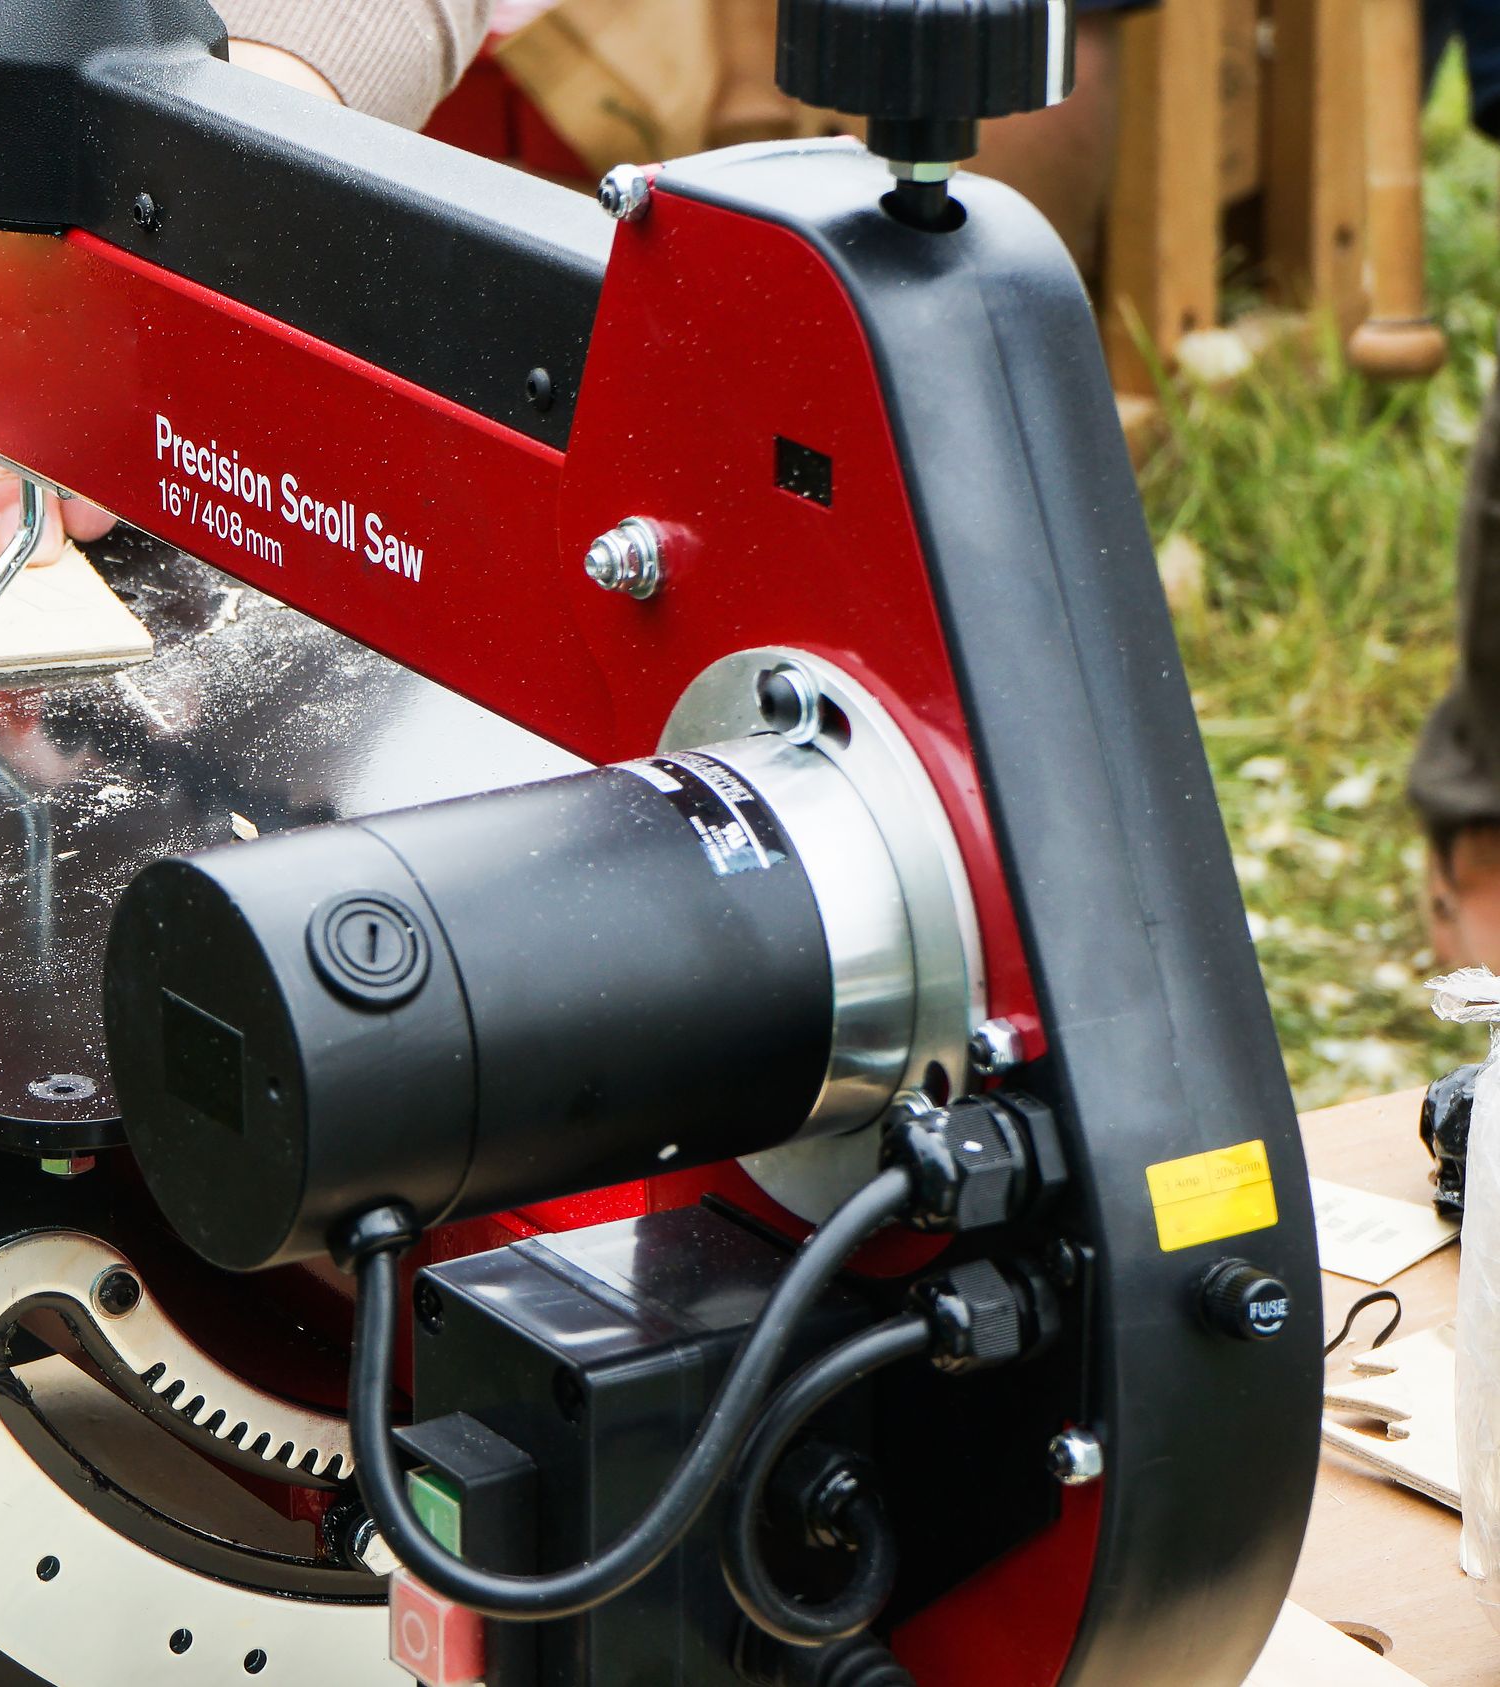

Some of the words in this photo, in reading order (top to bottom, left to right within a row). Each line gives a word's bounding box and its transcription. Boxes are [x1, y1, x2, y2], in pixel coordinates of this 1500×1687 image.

[156, 414, 272, 511] Precision
[280, 473, 355, 551] Scroll
[364, 512, 423, 583] Saw
[1249, 1298, 1290, 1319] FUSE
